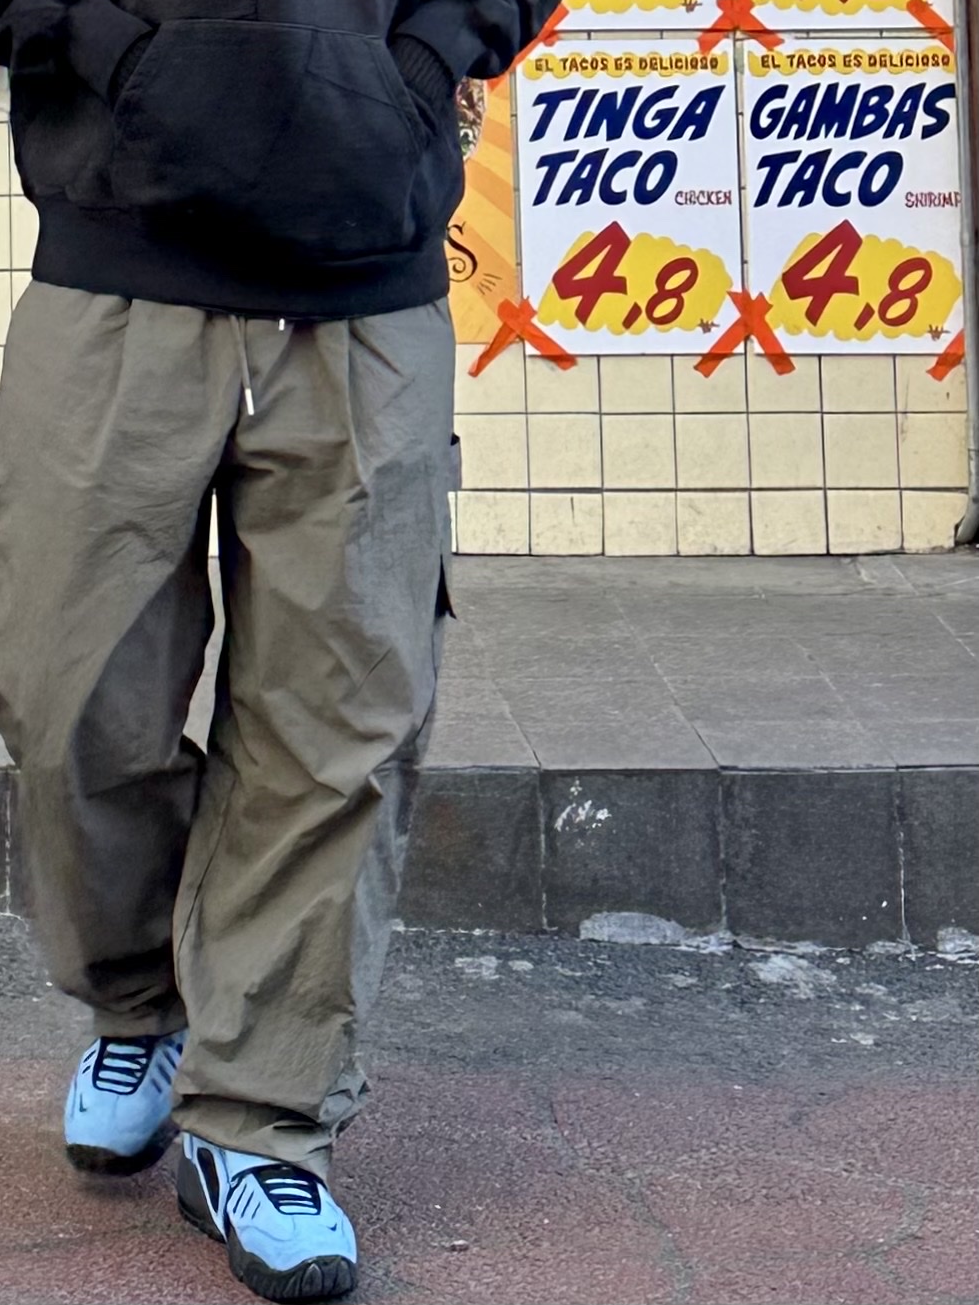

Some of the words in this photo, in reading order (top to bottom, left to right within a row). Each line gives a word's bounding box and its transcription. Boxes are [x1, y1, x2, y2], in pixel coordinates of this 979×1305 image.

[535, 59, 553, 72] EL
[560, 57, 609, 72] TACOS
[614, 58, 633, 71] ES
[638, 56, 719, 71] DELICIOSO
[761, 55, 780, 68] EL
[787, 53, 836, 68] TACOS
[843, 53, 862, 67] ES
[868, 53, 950, 67] DELICIOSO
[529, 84, 726, 142] TINGA
[750, 82, 956, 140] GAMBAS
[532, 148, 678, 207] TACO
[675, 190, 732, 206] CHICKEN
[753, 148, 904, 207] TACO
[552, 220, 699, 329] 4,8
[781, 219, 932, 331] 4,8
